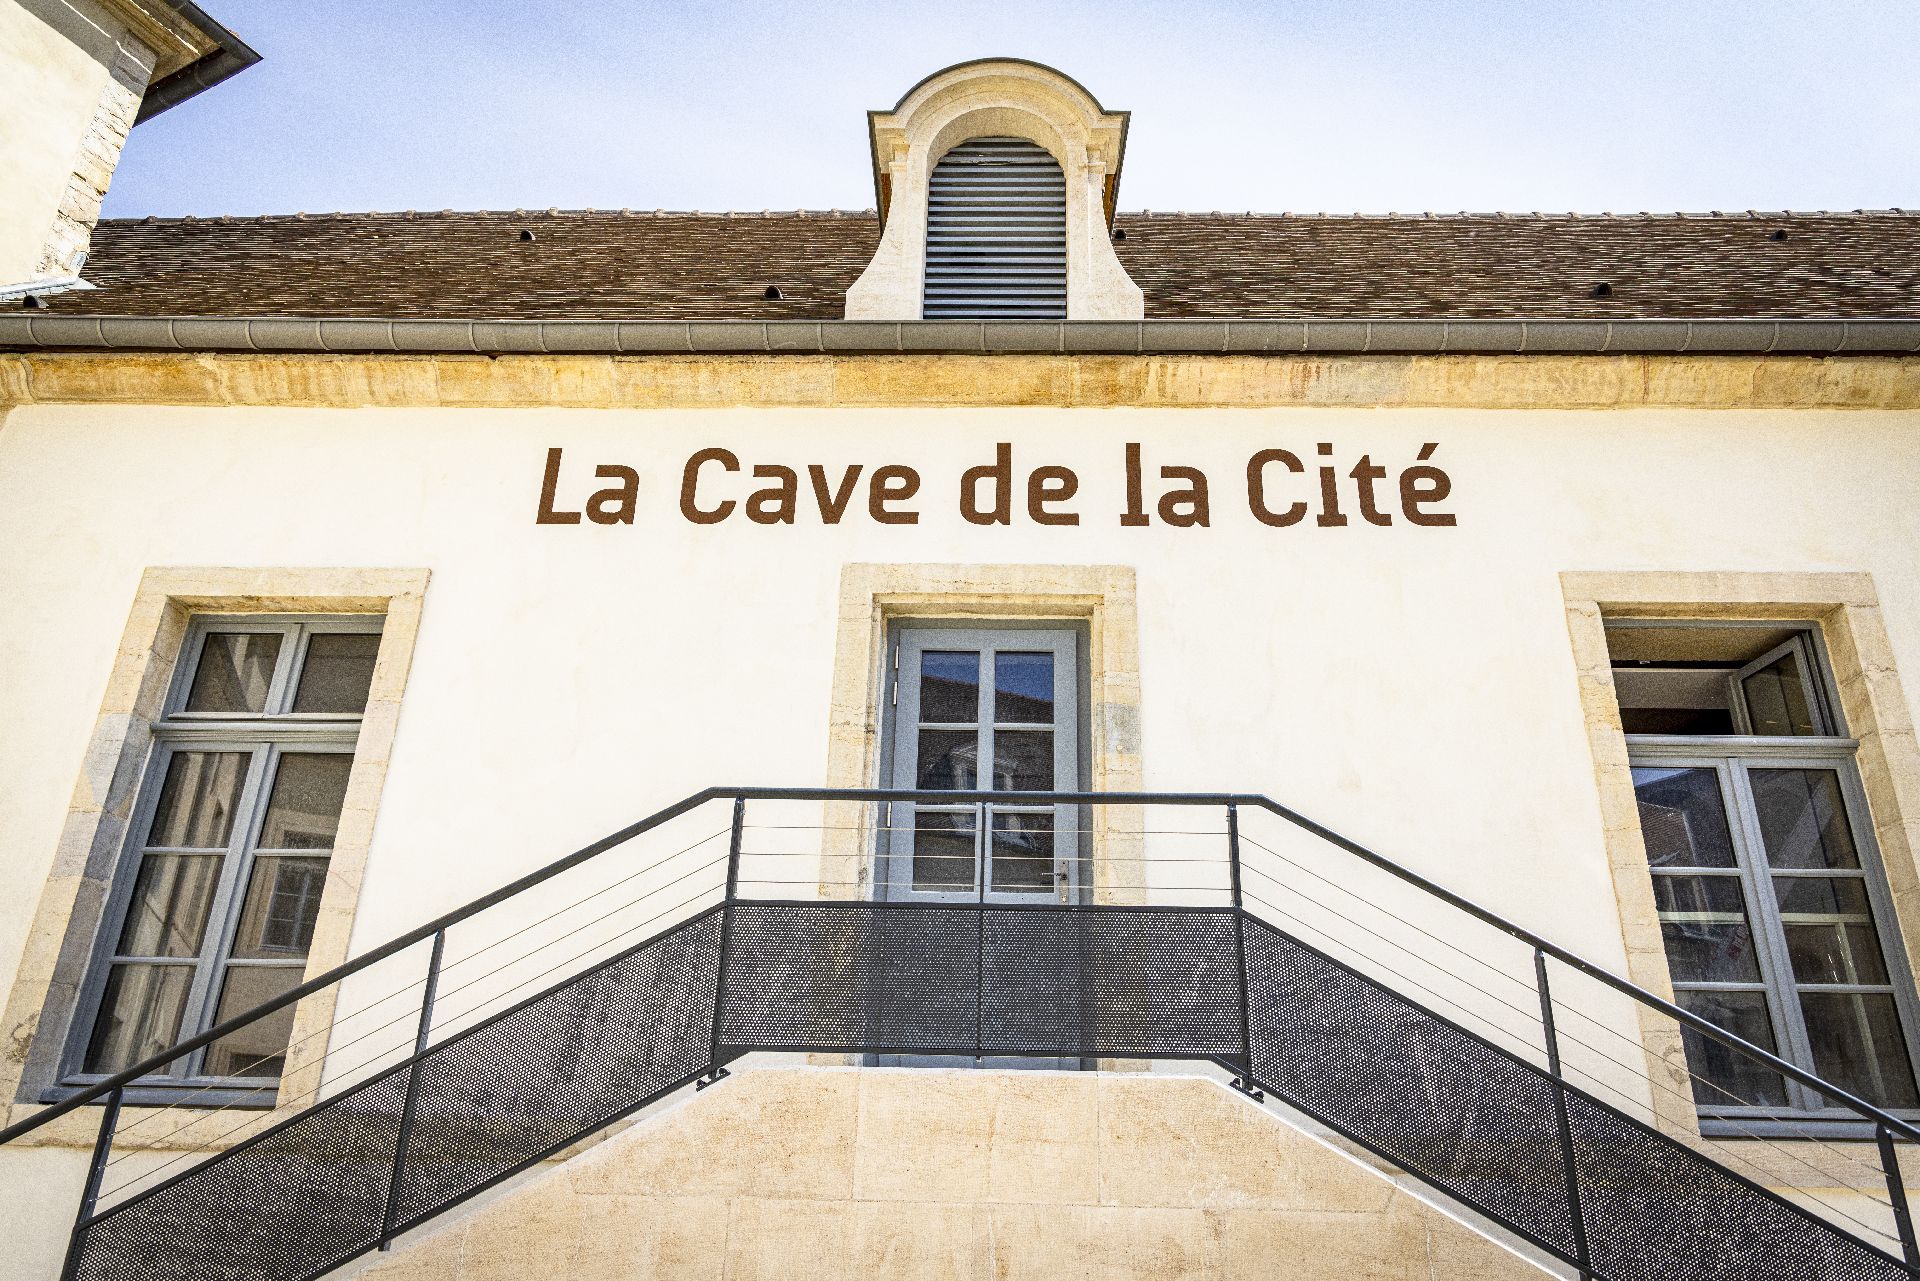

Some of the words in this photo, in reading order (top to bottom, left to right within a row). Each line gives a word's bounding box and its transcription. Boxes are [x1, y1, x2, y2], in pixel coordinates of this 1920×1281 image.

[536, 447, 640, 525] La
[680, 447, 921, 525] Cave
[960, 443, 1079, 526] de
[1120, 443, 1210, 527] la
[1247, 443, 1457, 528] Cité
